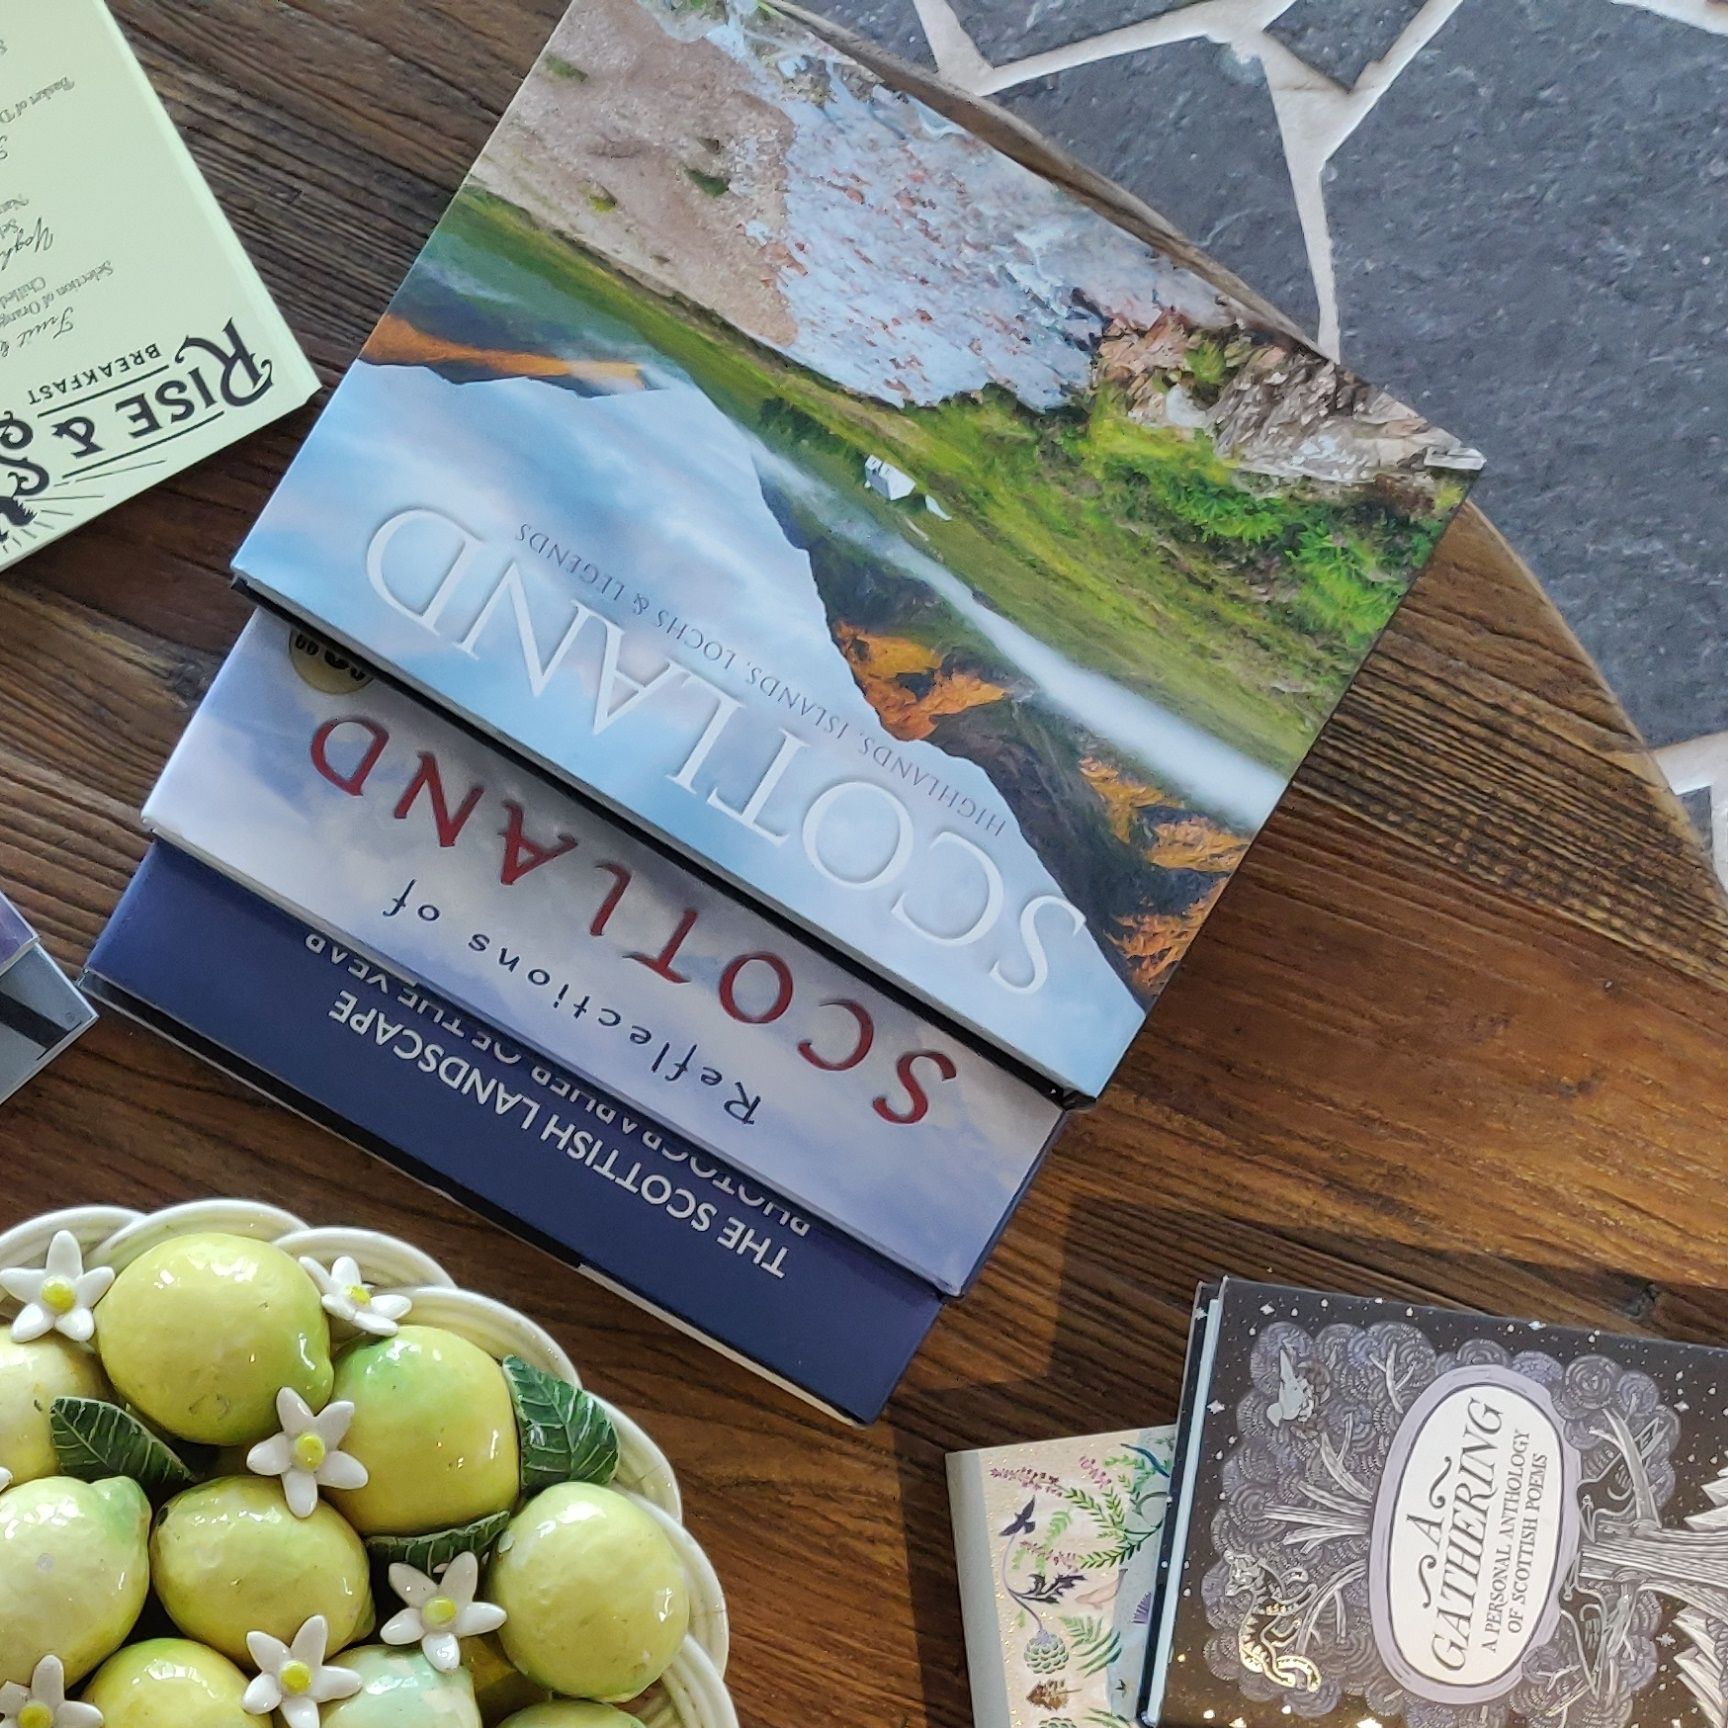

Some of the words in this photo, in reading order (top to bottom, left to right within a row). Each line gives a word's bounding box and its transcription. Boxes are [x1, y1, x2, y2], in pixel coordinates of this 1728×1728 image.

[39, 291, 56, 308] of
[54, 259, 114, 300] Selection
[14, 305, 75, 353] Fruit
[24, 342, 160, 405] BREAKFAST
[51, 415, 103, 462] &
[512, 519, 628, 603] LEGENDS
[627, 590, 652, 617] &
[651, 605, 739, 670] LOCHS
[366, 512, 1084, 997] SCOTLAND
[314, 715, 956, 1130] SCOTLAND
[382, 878, 441, 931] of
[326, 987, 542, 1130] LANDSCAPE
[462, 929, 762, 1126] Reflections
[538, 1111, 720, 1234] SCOTTISH
[715, 1214, 796, 1279] THE
[1498, 1428, 1530, 1536] ANTHOLOGY
[1525, 1452, 1547, 1511] POEMS
[1406, 1513, 1444, 1549] A
[1430, 1396, 1503, 1670] GATHERING
[1511, 1516, 1538, 1605] SCOTTISH
[1484, 1542, 1514, 1633] PERSONAL
[1480, 1638, 1498, 1652] A
[1506, 1610, 1524, 1633] OF
